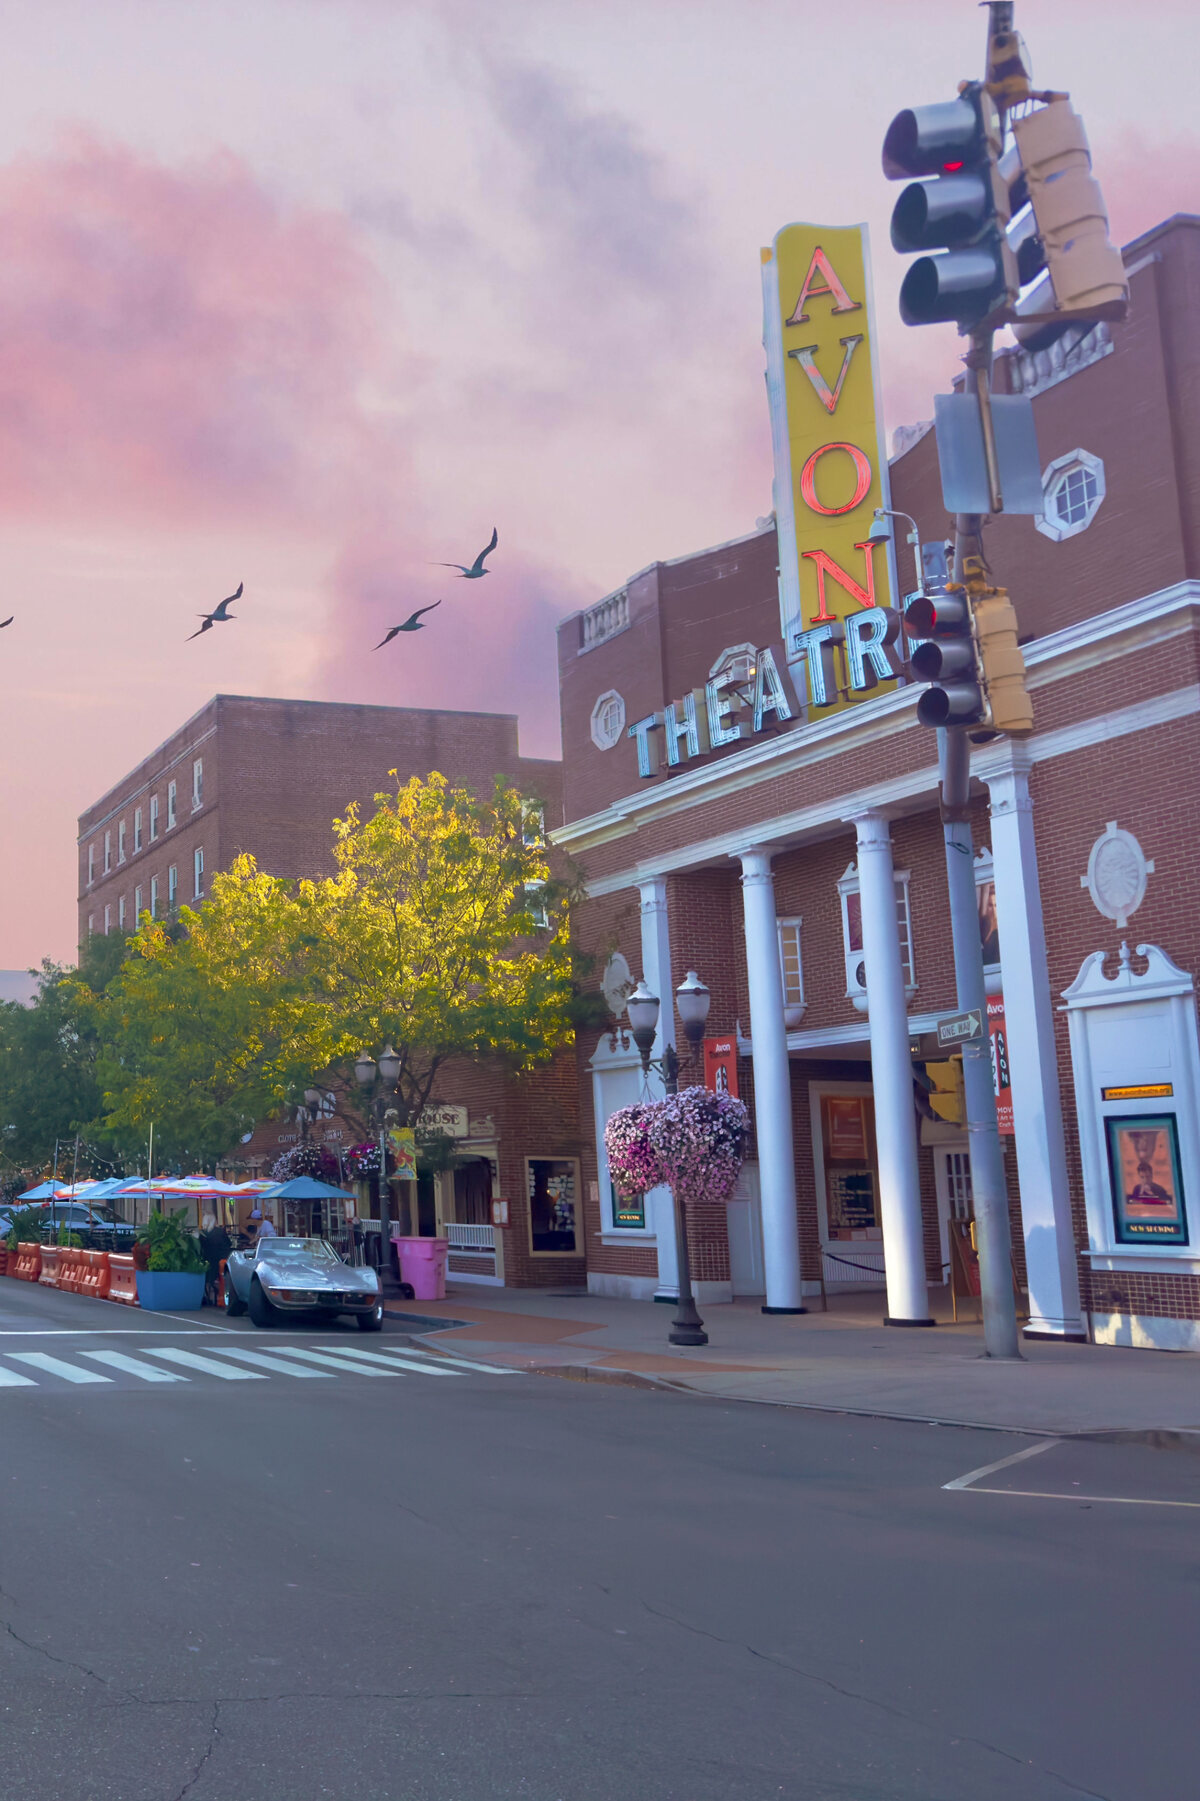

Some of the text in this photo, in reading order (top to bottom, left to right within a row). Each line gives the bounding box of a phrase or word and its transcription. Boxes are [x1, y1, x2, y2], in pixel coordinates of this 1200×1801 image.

[785, 245, 877, 622] AVON
[987, 1003, 1004, 1014] Avo
[942, 1021, 970, 1038] ONE WAY
[715, 1043, 731, 1053] Avon
